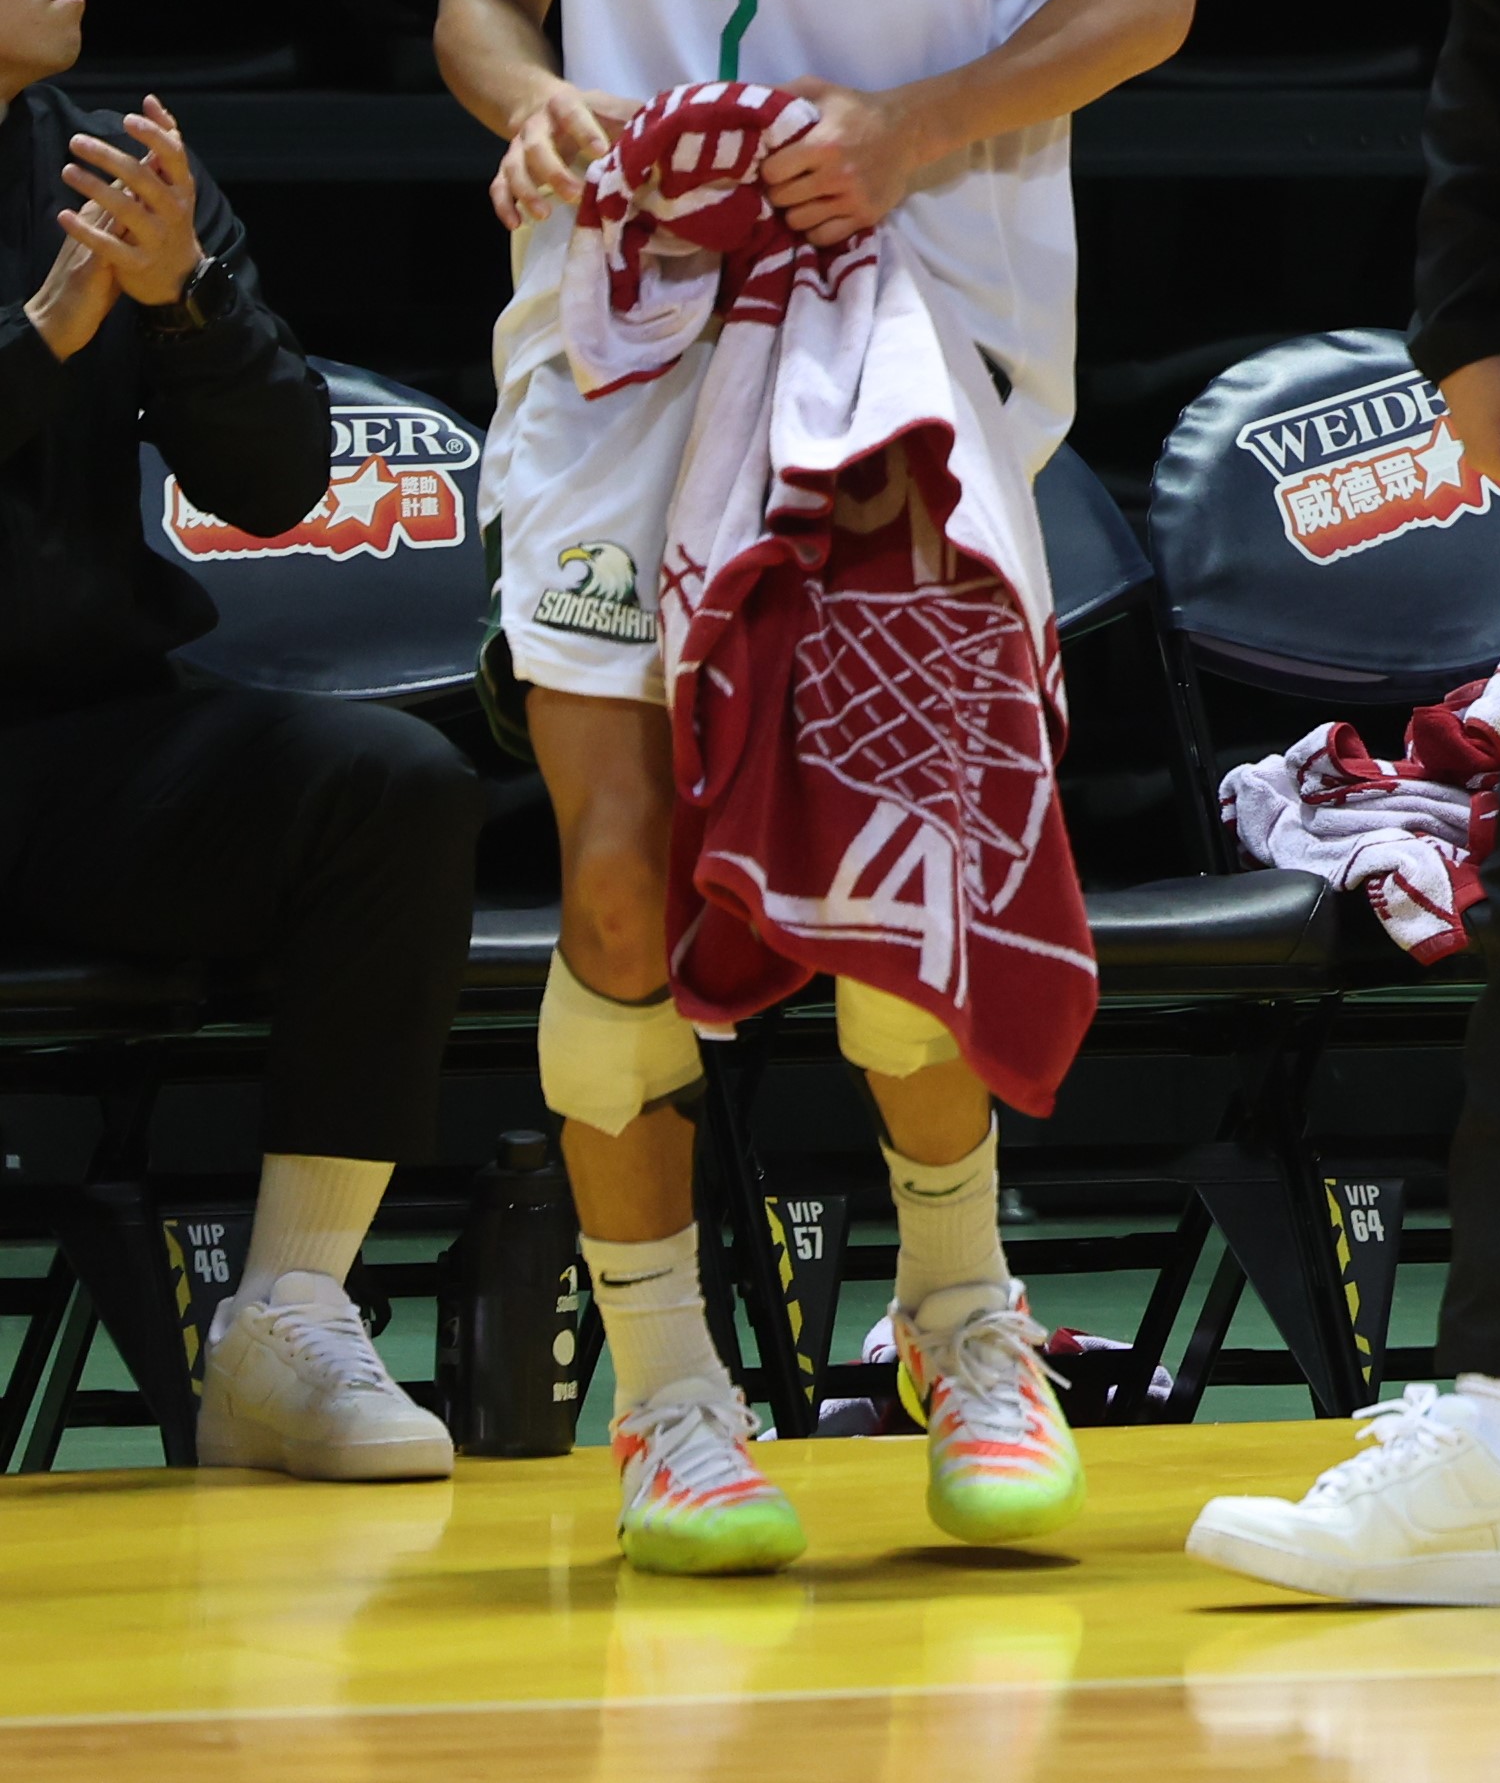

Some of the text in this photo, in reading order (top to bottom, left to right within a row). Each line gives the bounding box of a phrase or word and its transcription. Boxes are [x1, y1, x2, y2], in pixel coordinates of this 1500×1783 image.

[1254, 380, 1452, 471] WEIDE
[786, 1201, 824, 1223] VIP
[1344, 1185, 1381, 1206] VIP
[187, 1224, 225, 1246] VIP
[793, 1226, 824, 1260] 57
[1350, 1209, 1385, 1243] 64
[194, 1248, 230, 1283] 46
